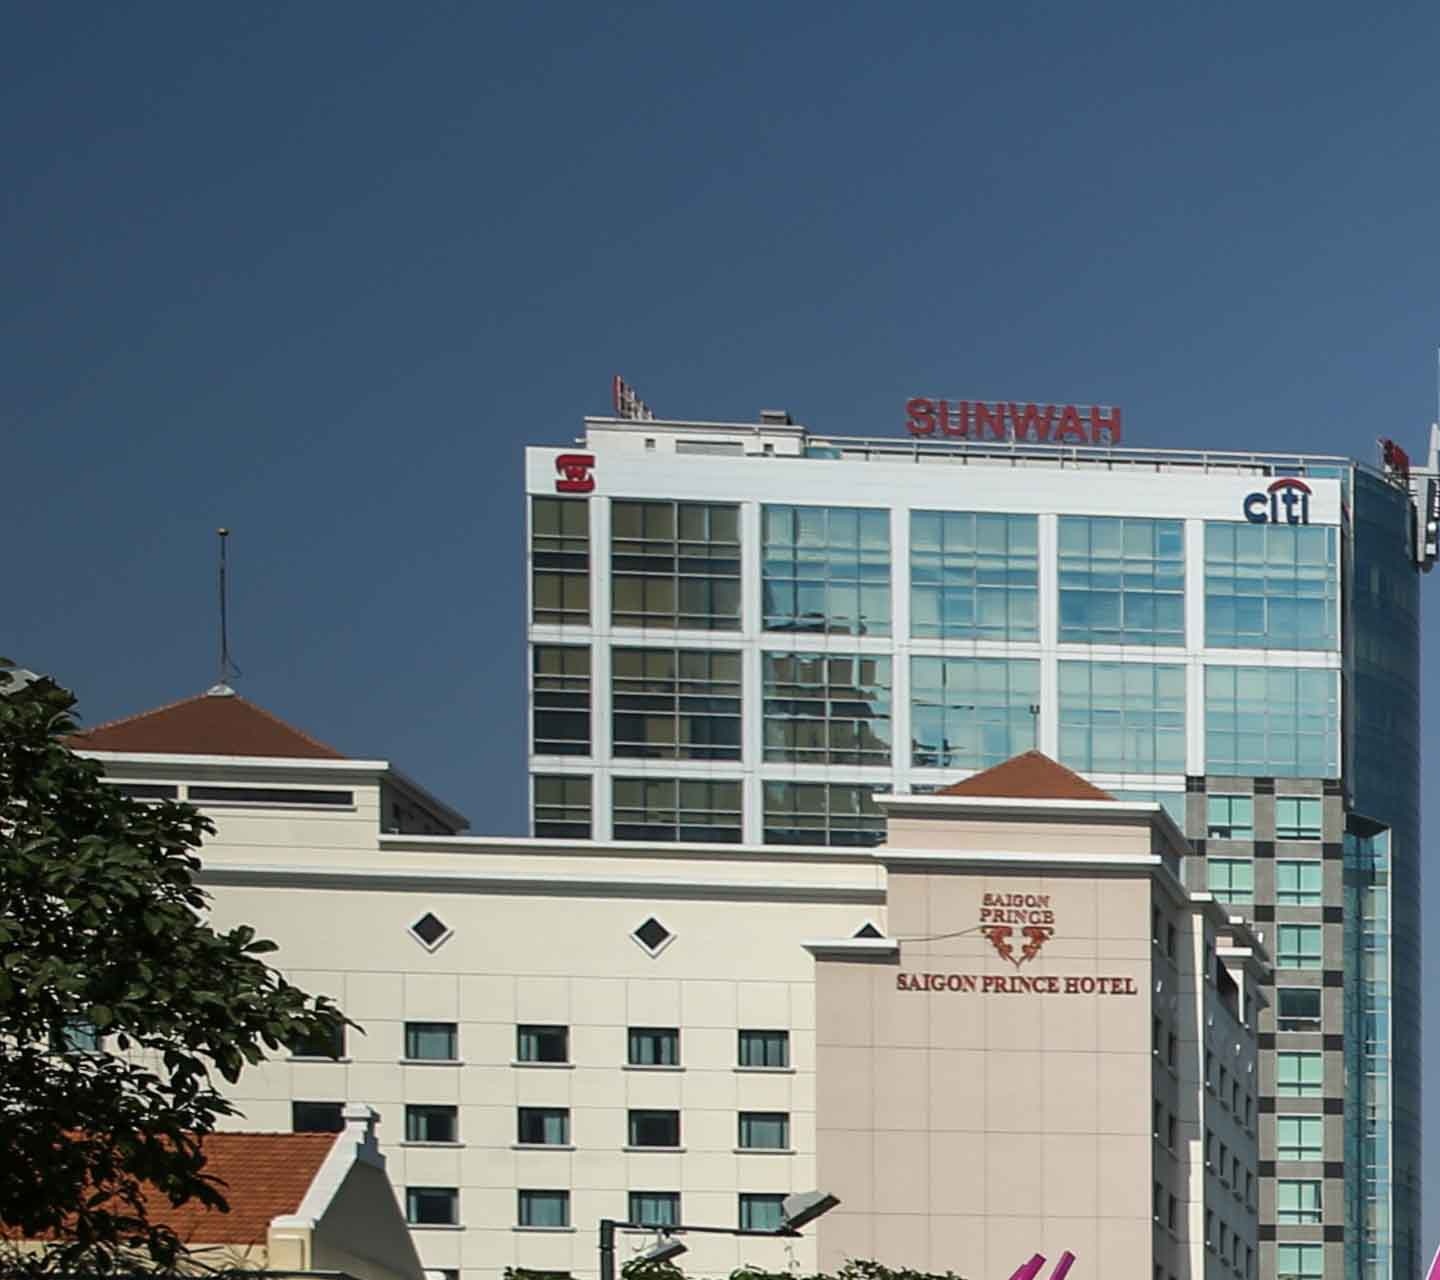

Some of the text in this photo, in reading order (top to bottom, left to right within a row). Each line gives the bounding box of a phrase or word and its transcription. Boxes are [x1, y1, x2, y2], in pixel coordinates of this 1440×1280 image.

[906, 398, 1121, 444] SUNWAH
[982, 893, 1050, 908] SAIGON
[979, 908, 1055, 924] PRINCE
[897, 973, 1138, 995] SAIGON PRINCE HOTEL
